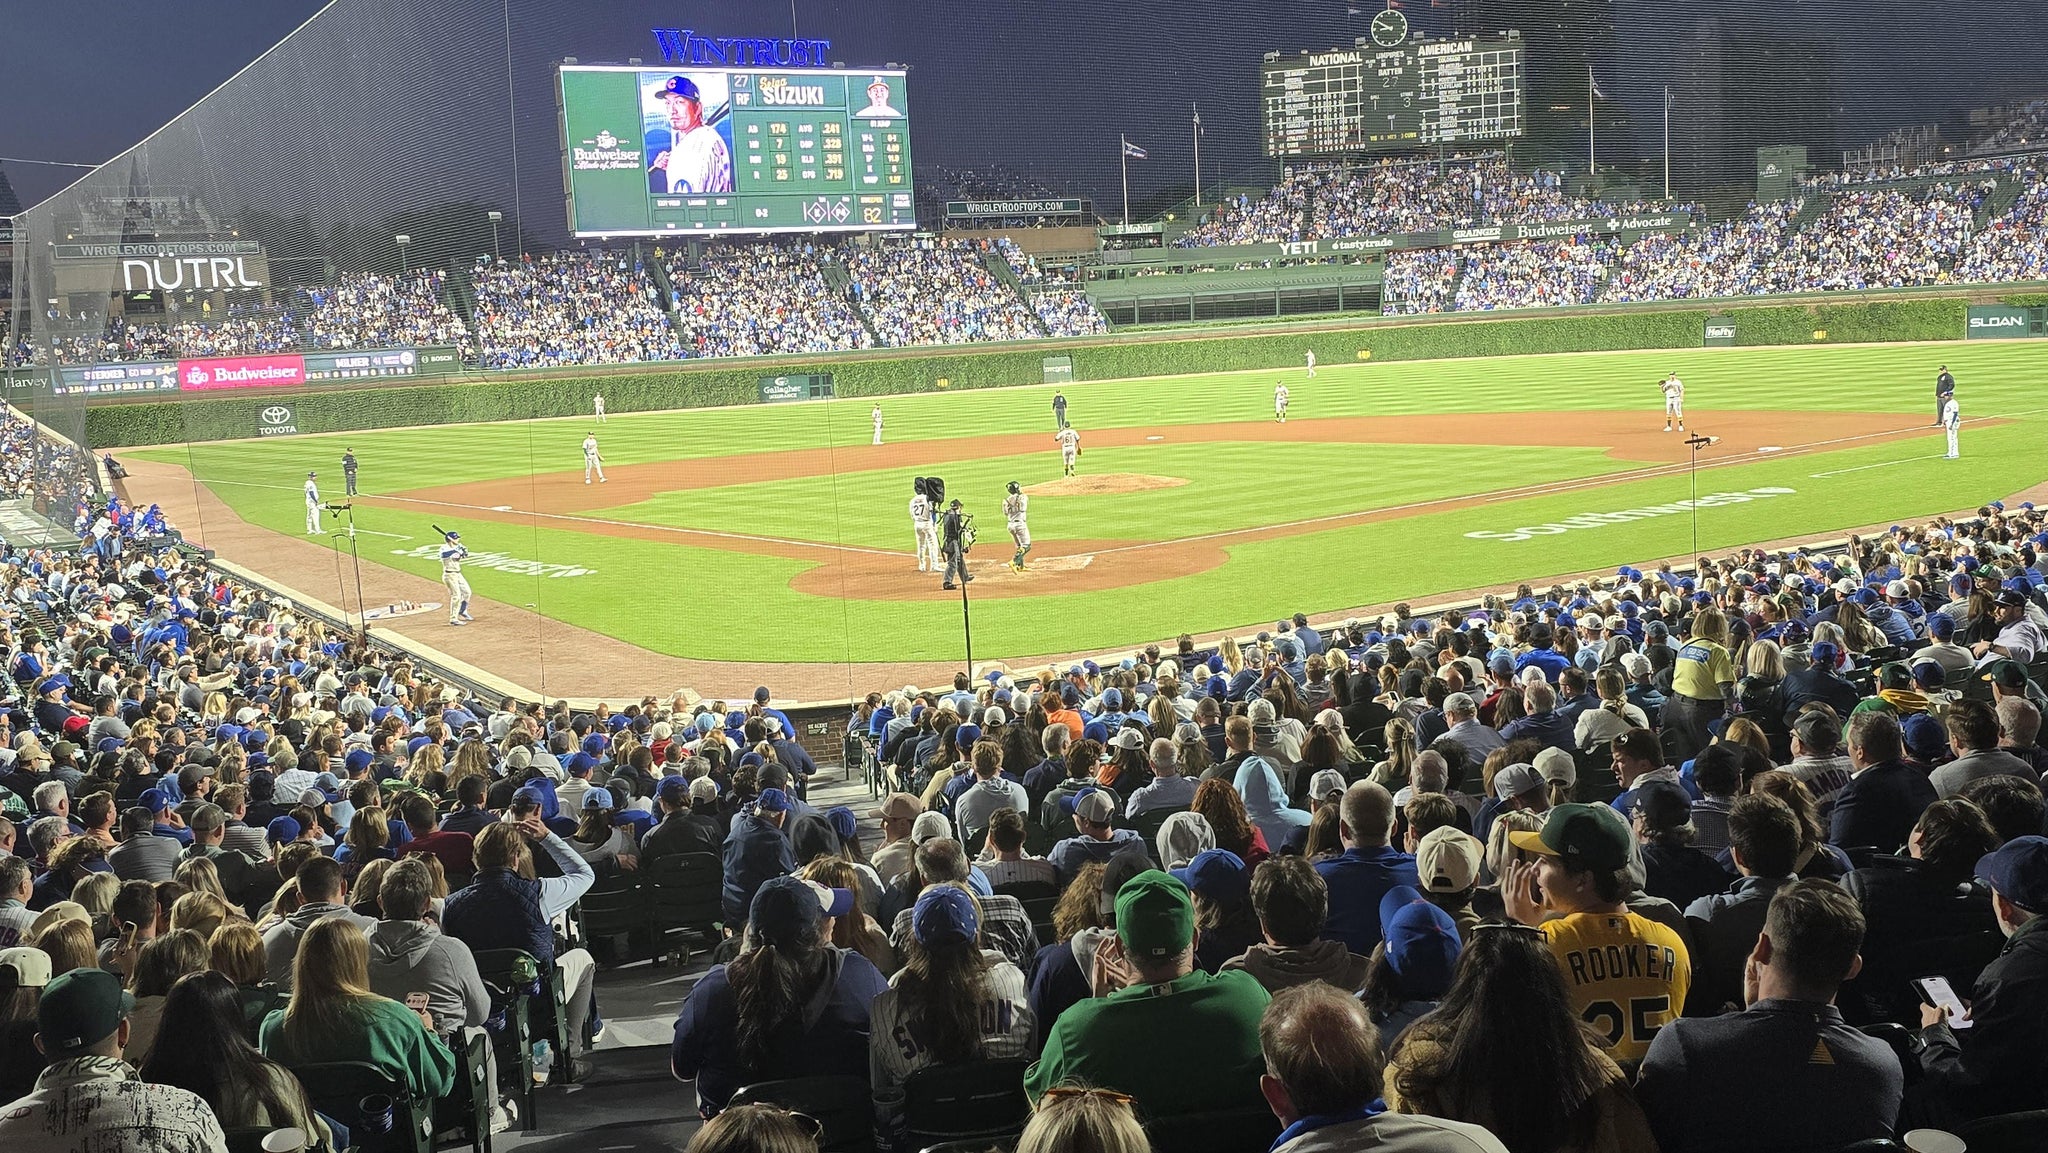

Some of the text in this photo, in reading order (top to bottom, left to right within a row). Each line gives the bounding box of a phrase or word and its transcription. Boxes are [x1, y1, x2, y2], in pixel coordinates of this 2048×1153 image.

[650, 28, 831, 67] WINTRUST
[1418, 41, 1473, 57] AMERICAN
[1309, 52, 1363, 67] NATIONAL
[734, 75, 748, 87] 27
[736, 93, 750, 105] RF
[763, 86, 824, 105] SUZUKI
[770, 124, 786, 134] 174
[776, 138, 783, 149] 7
[574, 148, 640, 160] Budweiser
[966, 201, 1064, 214] WRIGLEYROOFTOPS.COM
[864, 207, 882, 223] 82
[1622, 216, 1673, 229] Advocate
[1453, 228, 1502, 238] GRAINGER
[1518, 222, 1593, 238] Budweiser
[81, 244, 237, 256] WRIGLEYROOFTOPS.COM
[1278, 242, 1318, 256] YETI
[1340, 238, 1394, 250] tastytrade
[1708, 328, 1734, 336] Hefty
[214, 366, 298, 382] Budweiser
[4, 378, 48, 388] Harvey
[764, 386, 801, 394] Gallagher
[260, 426, 296, 434] TOYOTA
[914, 505, 924, 516] 27
[1463, 487, 1797, 541] Southwest
[1566, 943, 1676, 985] ROOKER
